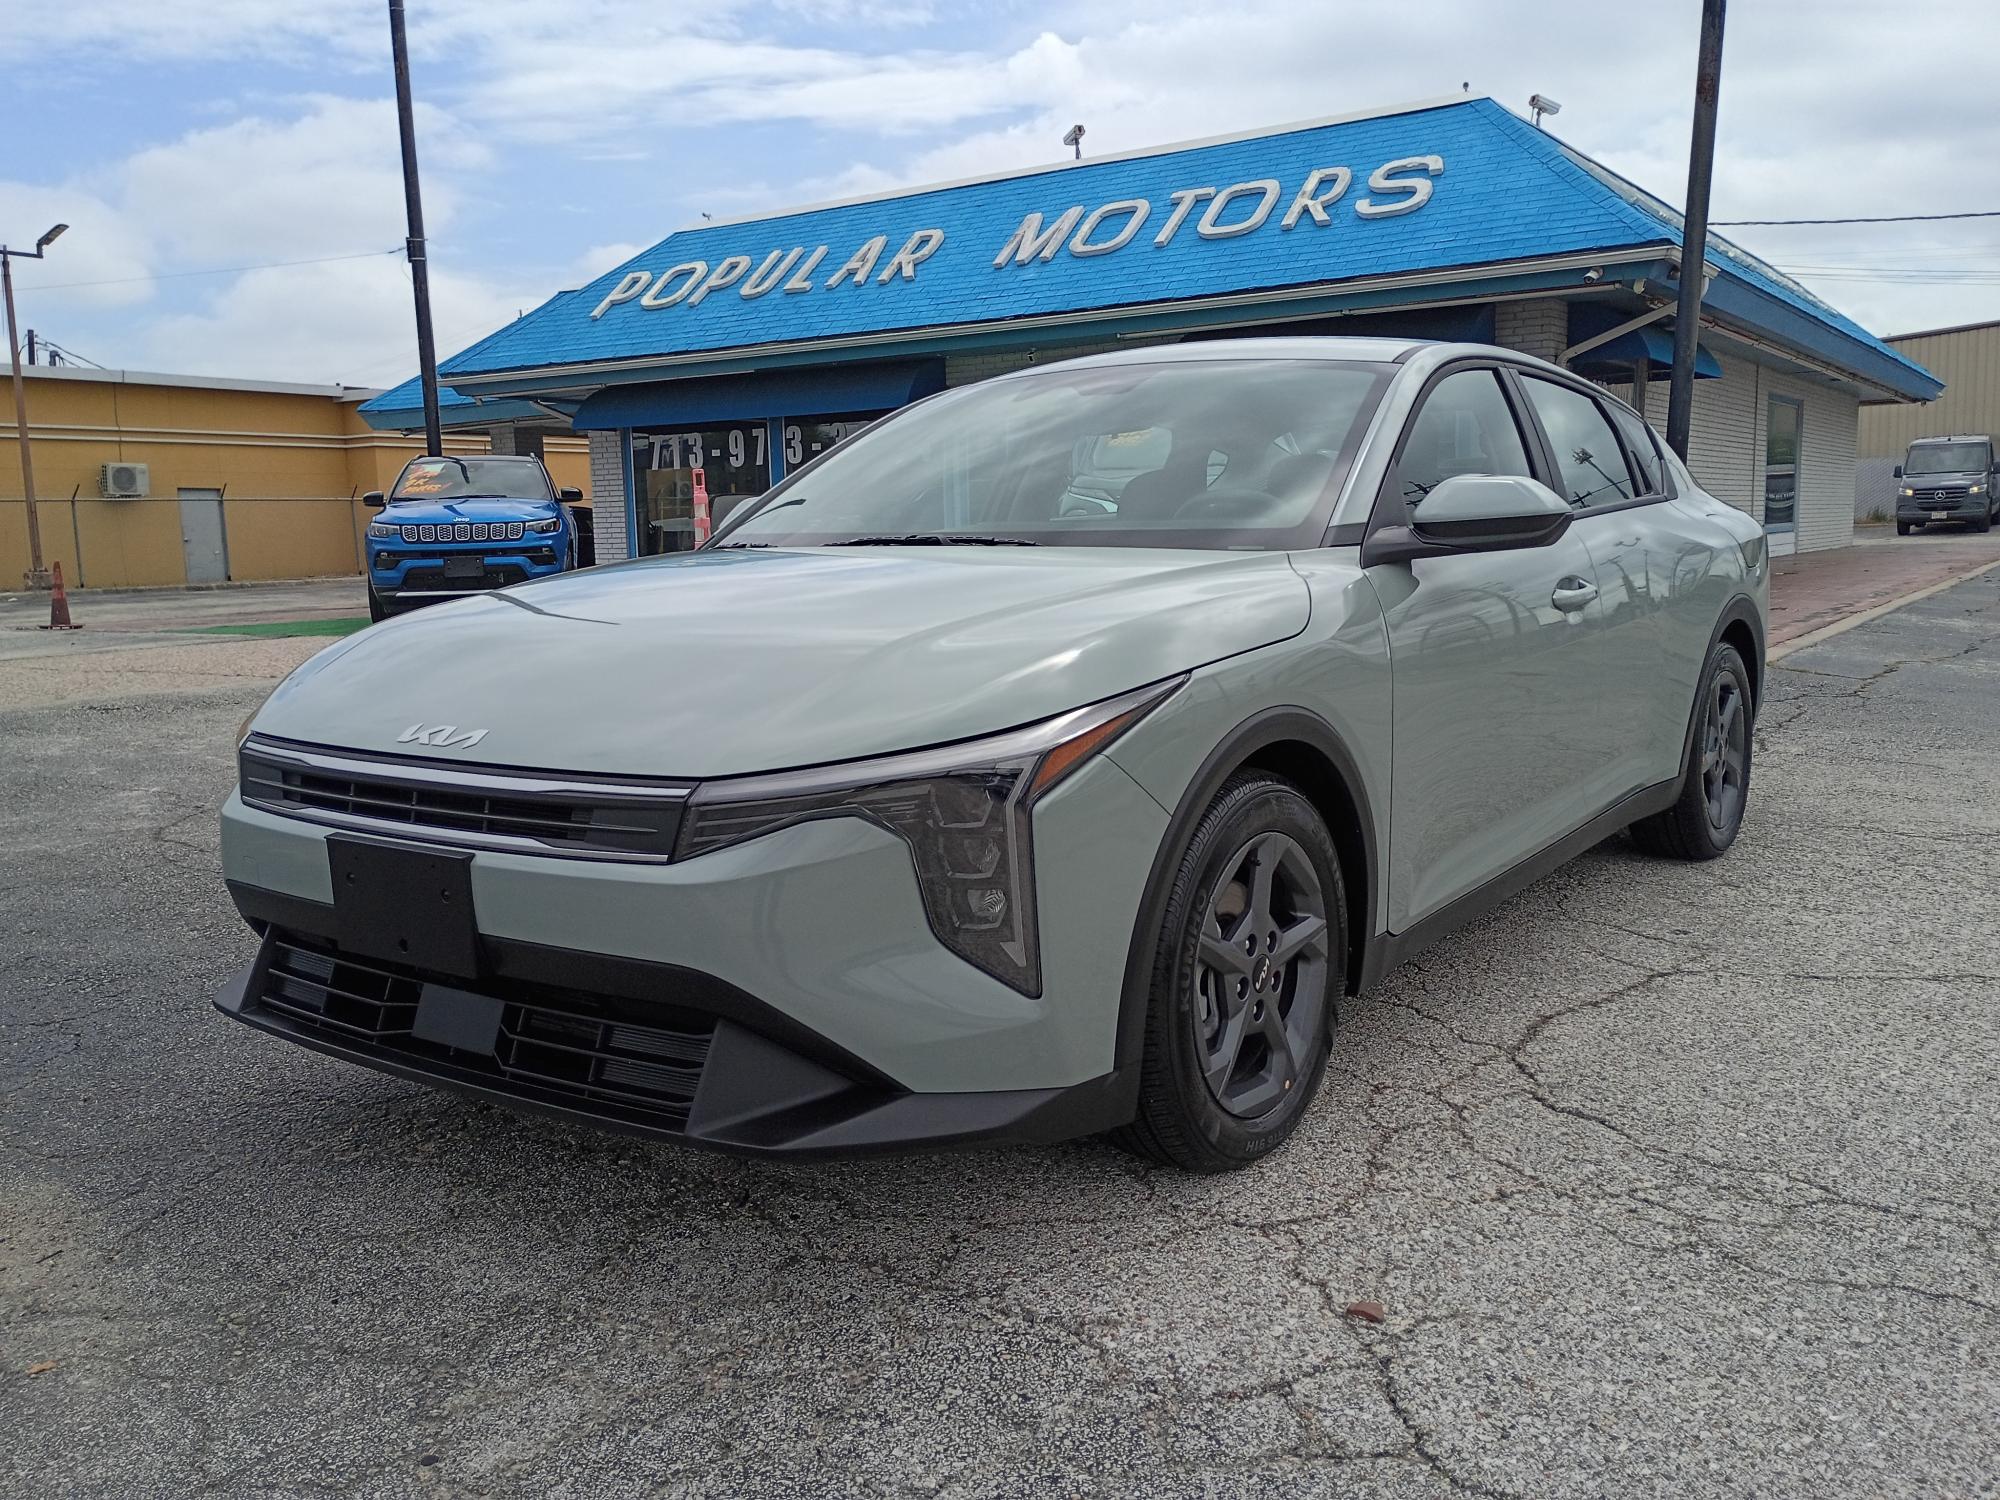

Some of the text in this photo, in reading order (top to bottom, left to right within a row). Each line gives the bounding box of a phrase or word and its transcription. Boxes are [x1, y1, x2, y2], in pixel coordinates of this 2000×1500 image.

[589, 154, 1445, 321] POPULAR MOTORS
[1178, 888, 1207, 1012] KUMHO
